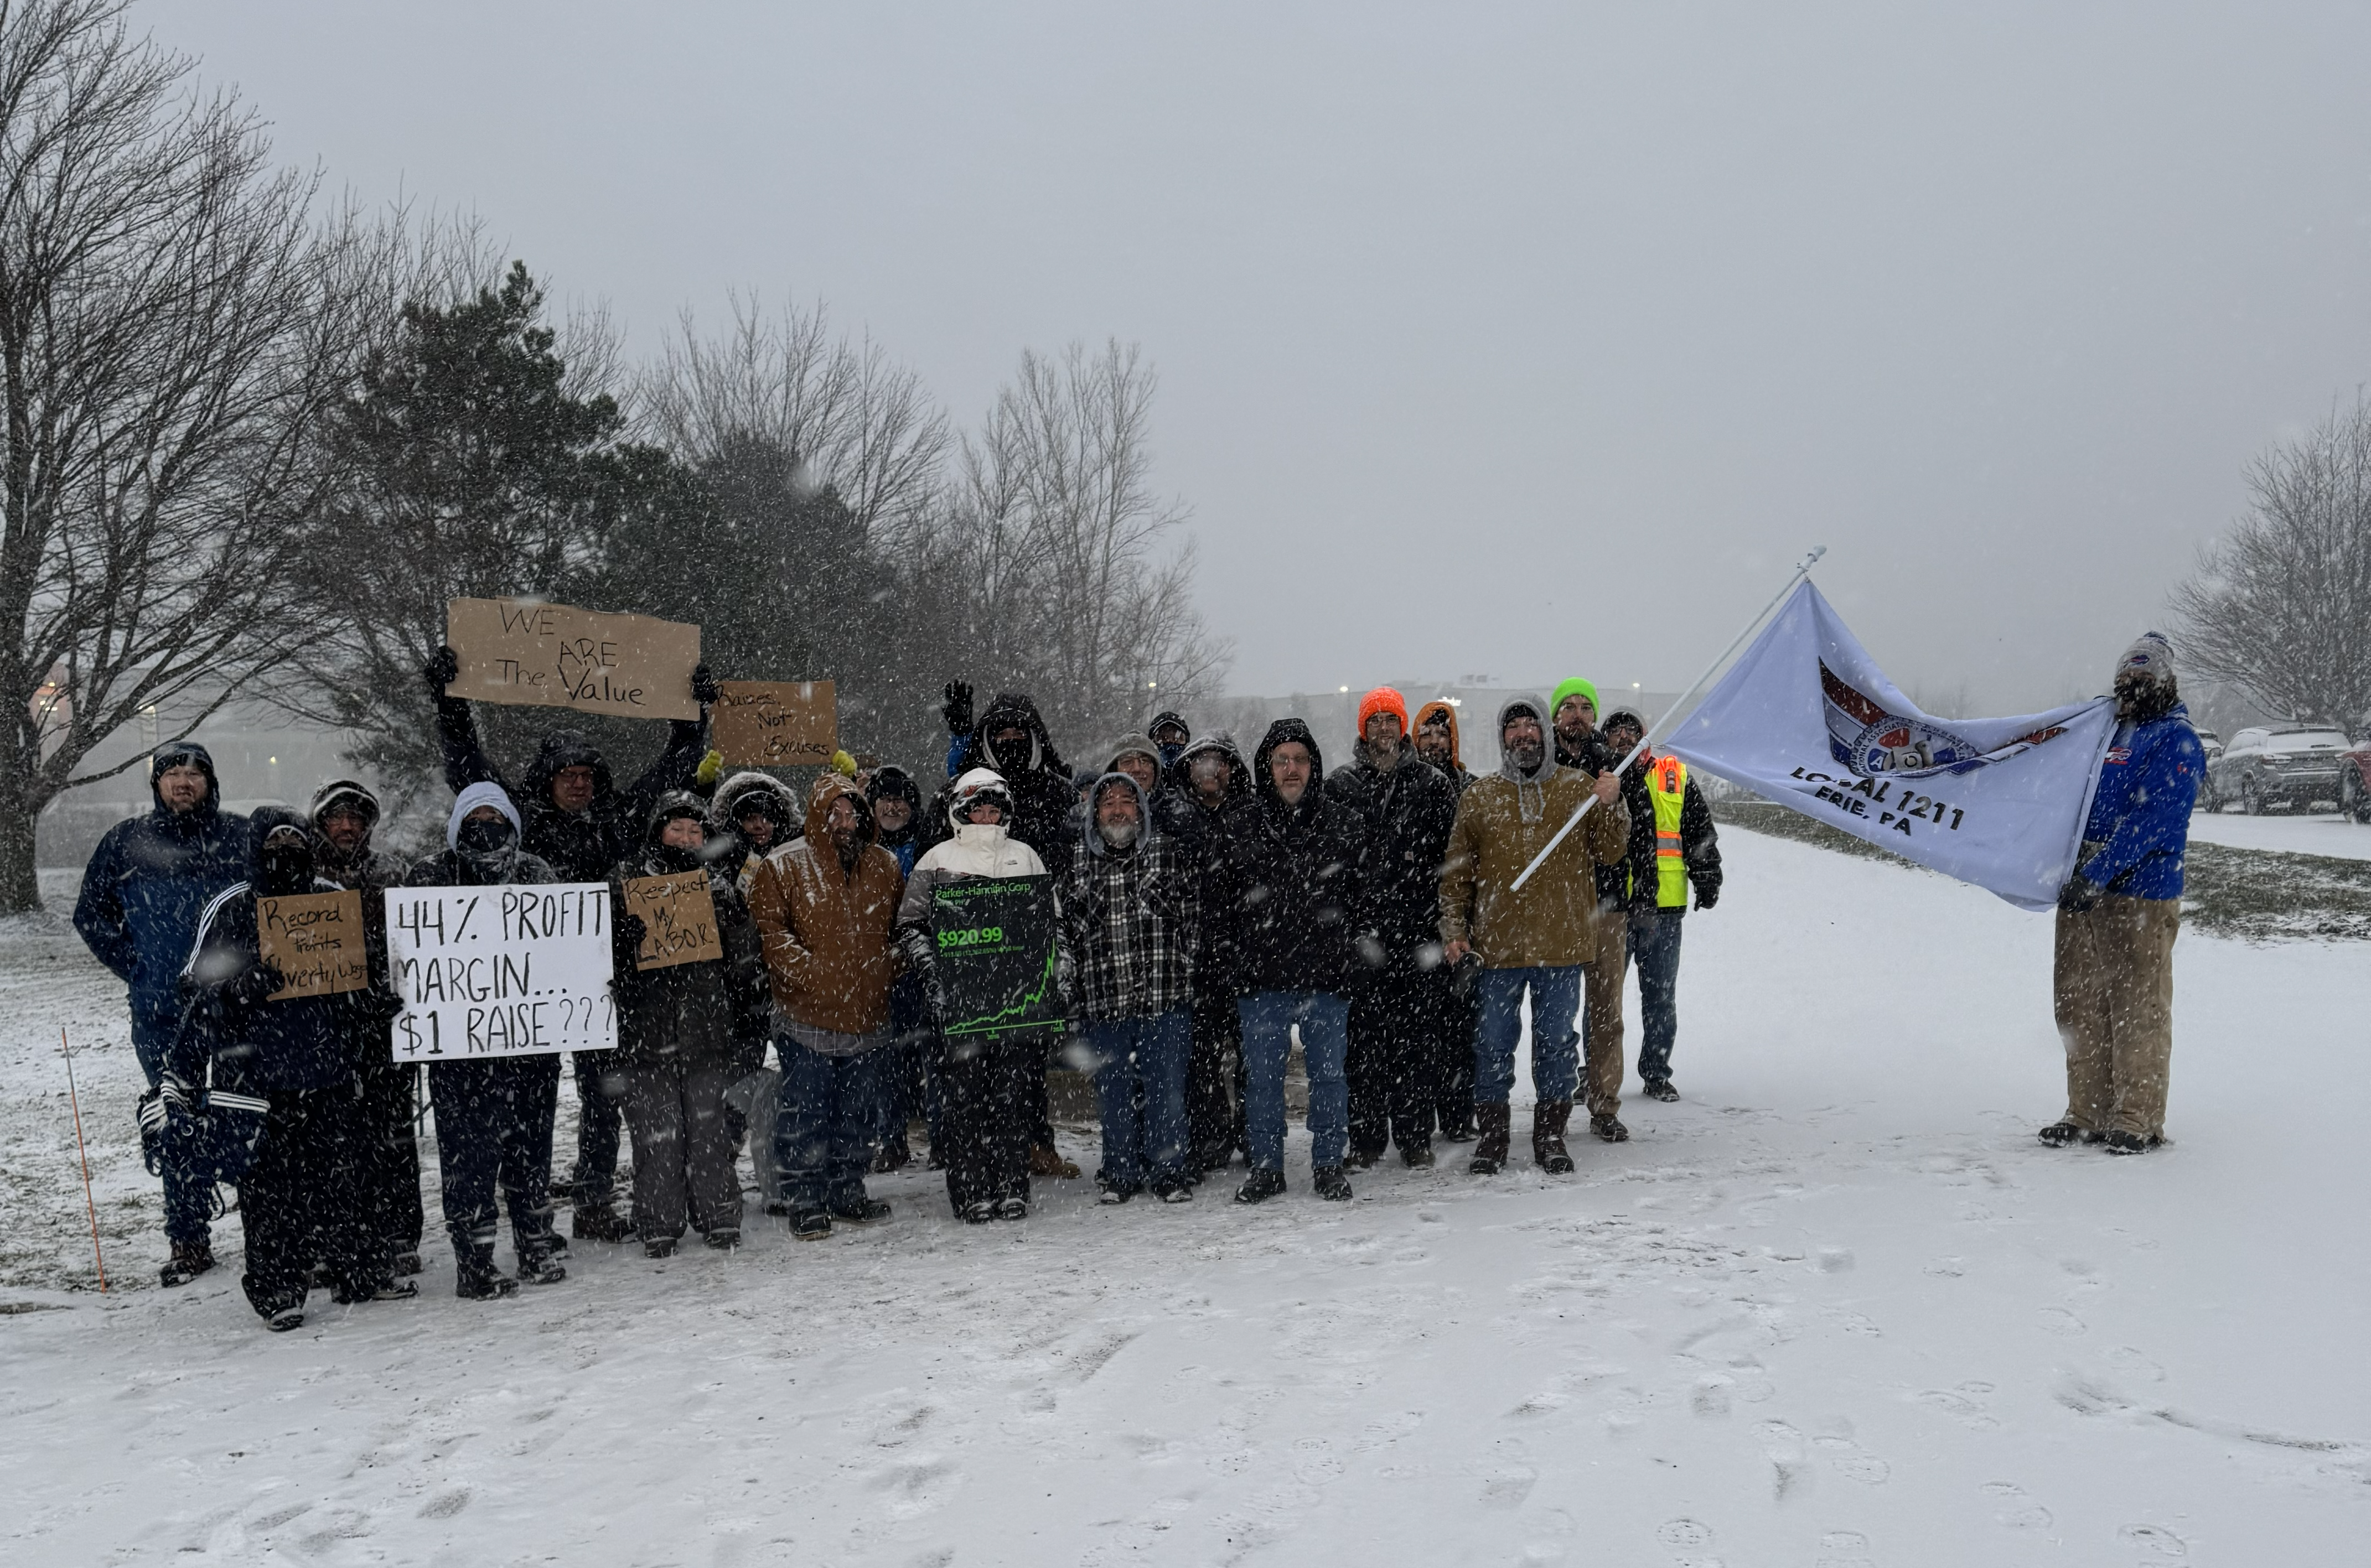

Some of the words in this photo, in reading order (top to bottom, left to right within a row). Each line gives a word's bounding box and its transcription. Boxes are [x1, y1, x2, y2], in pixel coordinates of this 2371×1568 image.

[500, 603, 555, 635] WE
[559, 638, 618, 667] ARE
[496, 659, 545, 686] The
[557, 664, 646, 705] Value
[757, 707, 792, 730] Not
[1815, 786, 1870, 819] ERIE,
[1879, 812, 1911, 836] PA
[1897, 791, 1964, 830] 1211
[625, 874, 708, 905] Respect
[936, 882, 1007, 899] Parker-Hannifin
[1008, 882, 1031, 892] Corp
[261, 900, 343, 932] Record
[400, 896, 479, 948] 44%
[503, 890, 609, 941] PROFIT
[637, 923, 714, 963] LABOR
[937, 927, 1003, 949] $920.99
[265, 954, 335, 995] verty
[399, 1011, 443, 1056] $1
